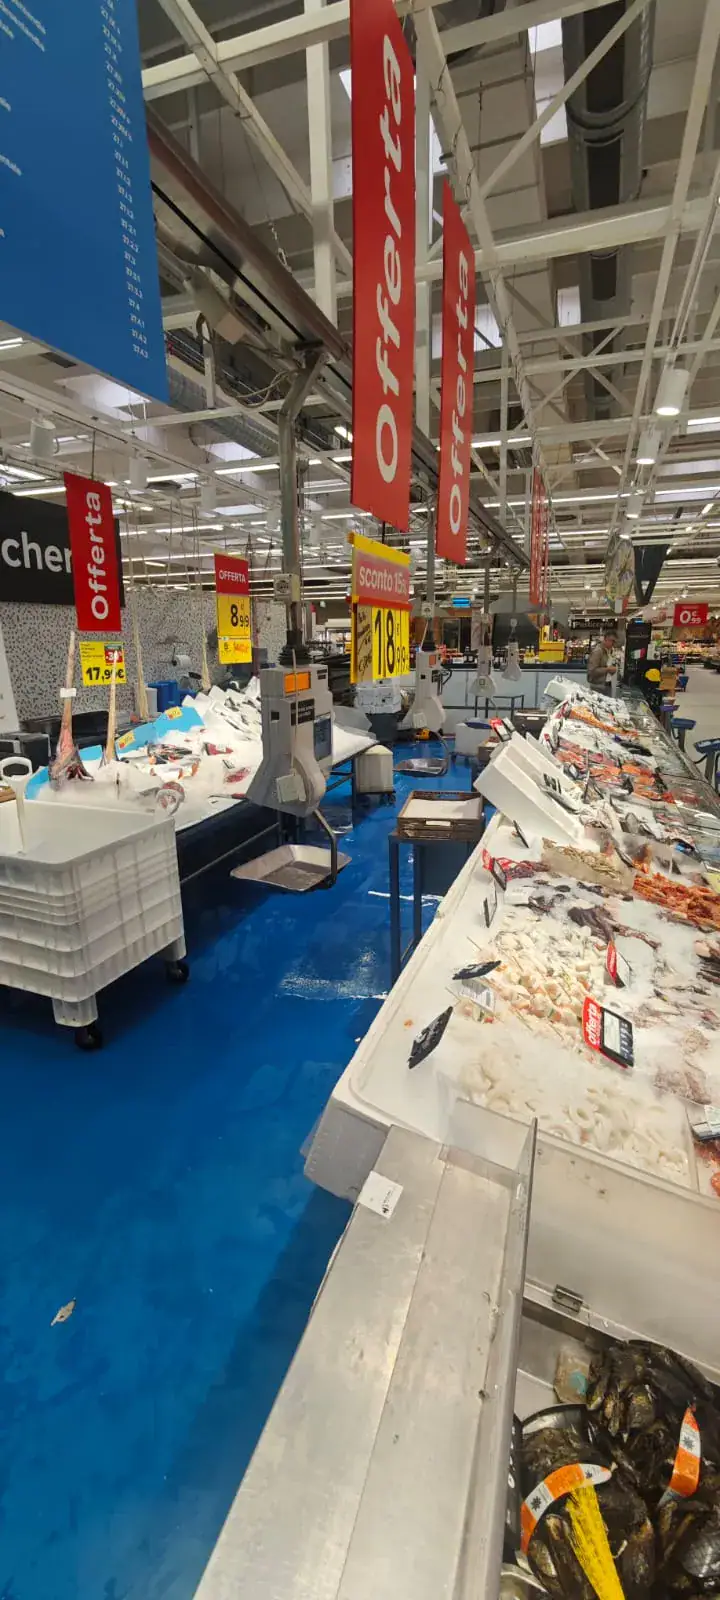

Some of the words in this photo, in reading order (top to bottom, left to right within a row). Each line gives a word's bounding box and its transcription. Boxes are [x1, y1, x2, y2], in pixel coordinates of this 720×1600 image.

[375, 34, 401, 483] Offerta
[448, 249, 469, 535] Offerta
[85, 492, 109, 620] Offerta
[219, 570, 246, 584] OFFERTA
[359, 566, 393, 592] sconto
[230, 604, 239, 627] 8
[374, 609, 395, 675] 18
[86, 667, 125, 683] 17,9€
